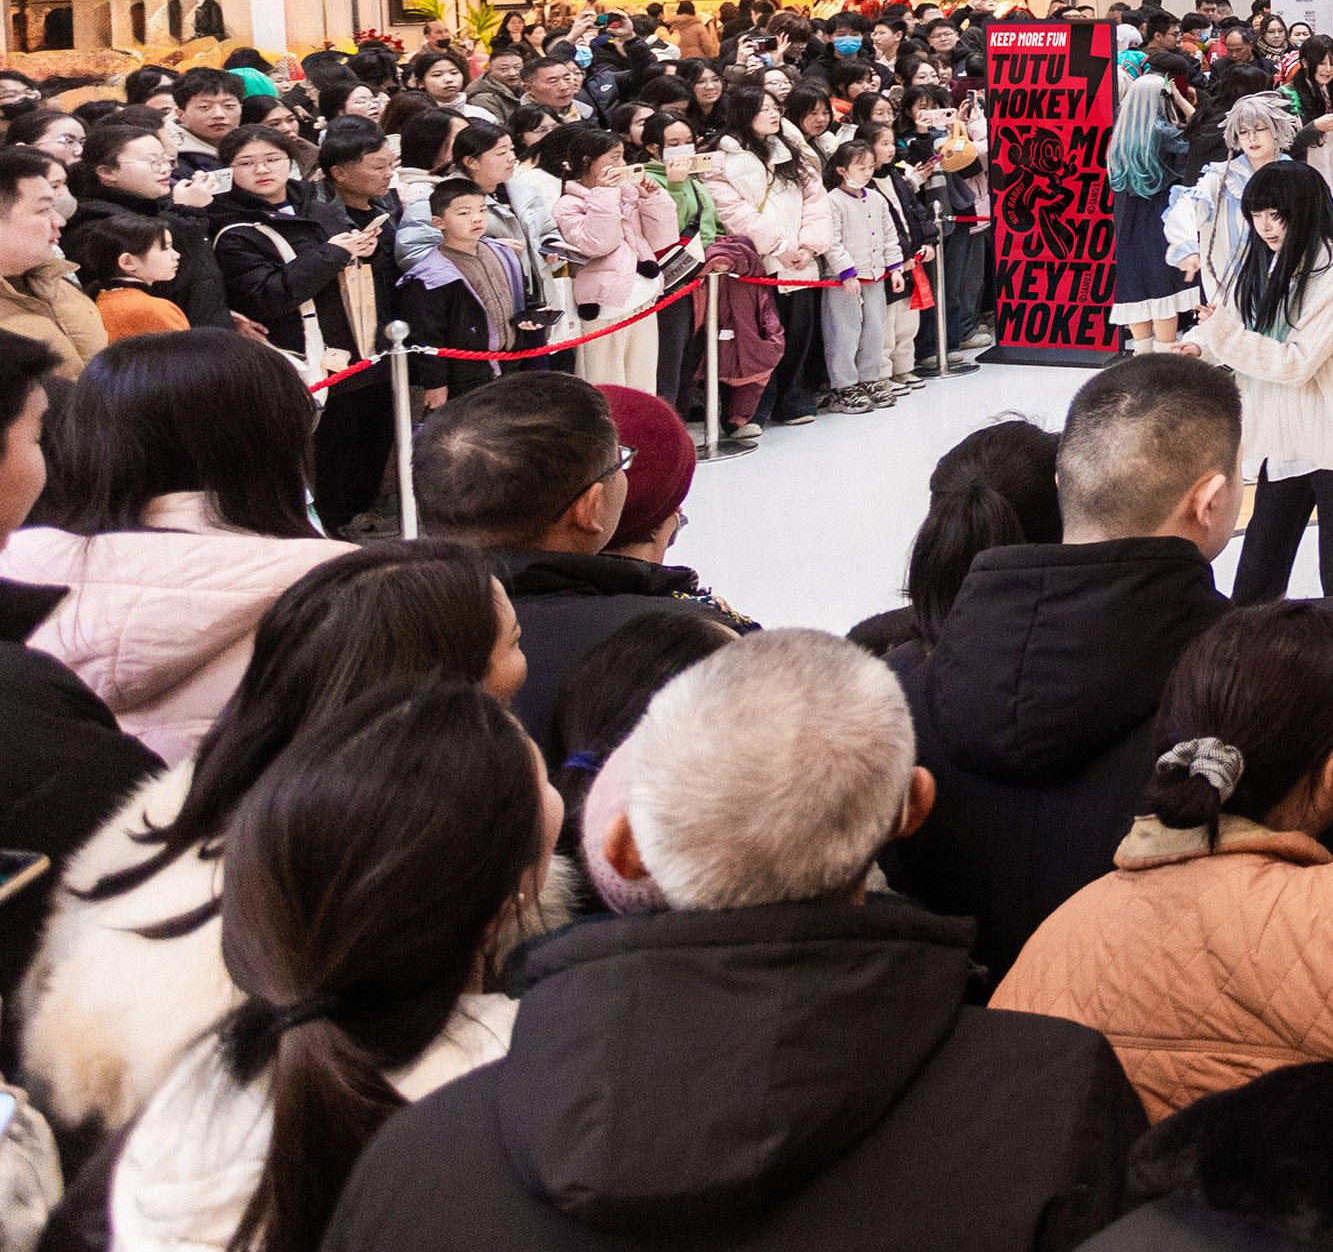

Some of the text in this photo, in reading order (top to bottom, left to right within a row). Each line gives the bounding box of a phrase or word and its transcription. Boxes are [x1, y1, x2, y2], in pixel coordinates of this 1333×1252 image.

[990, 32, 1067, 47] KEEP MORE FUN
[991, 53, 1065, 85] TUTU
[988, 88, 1086, 119] MOKEY
[1008, 182, 1026, 225] NOT RABBIT
